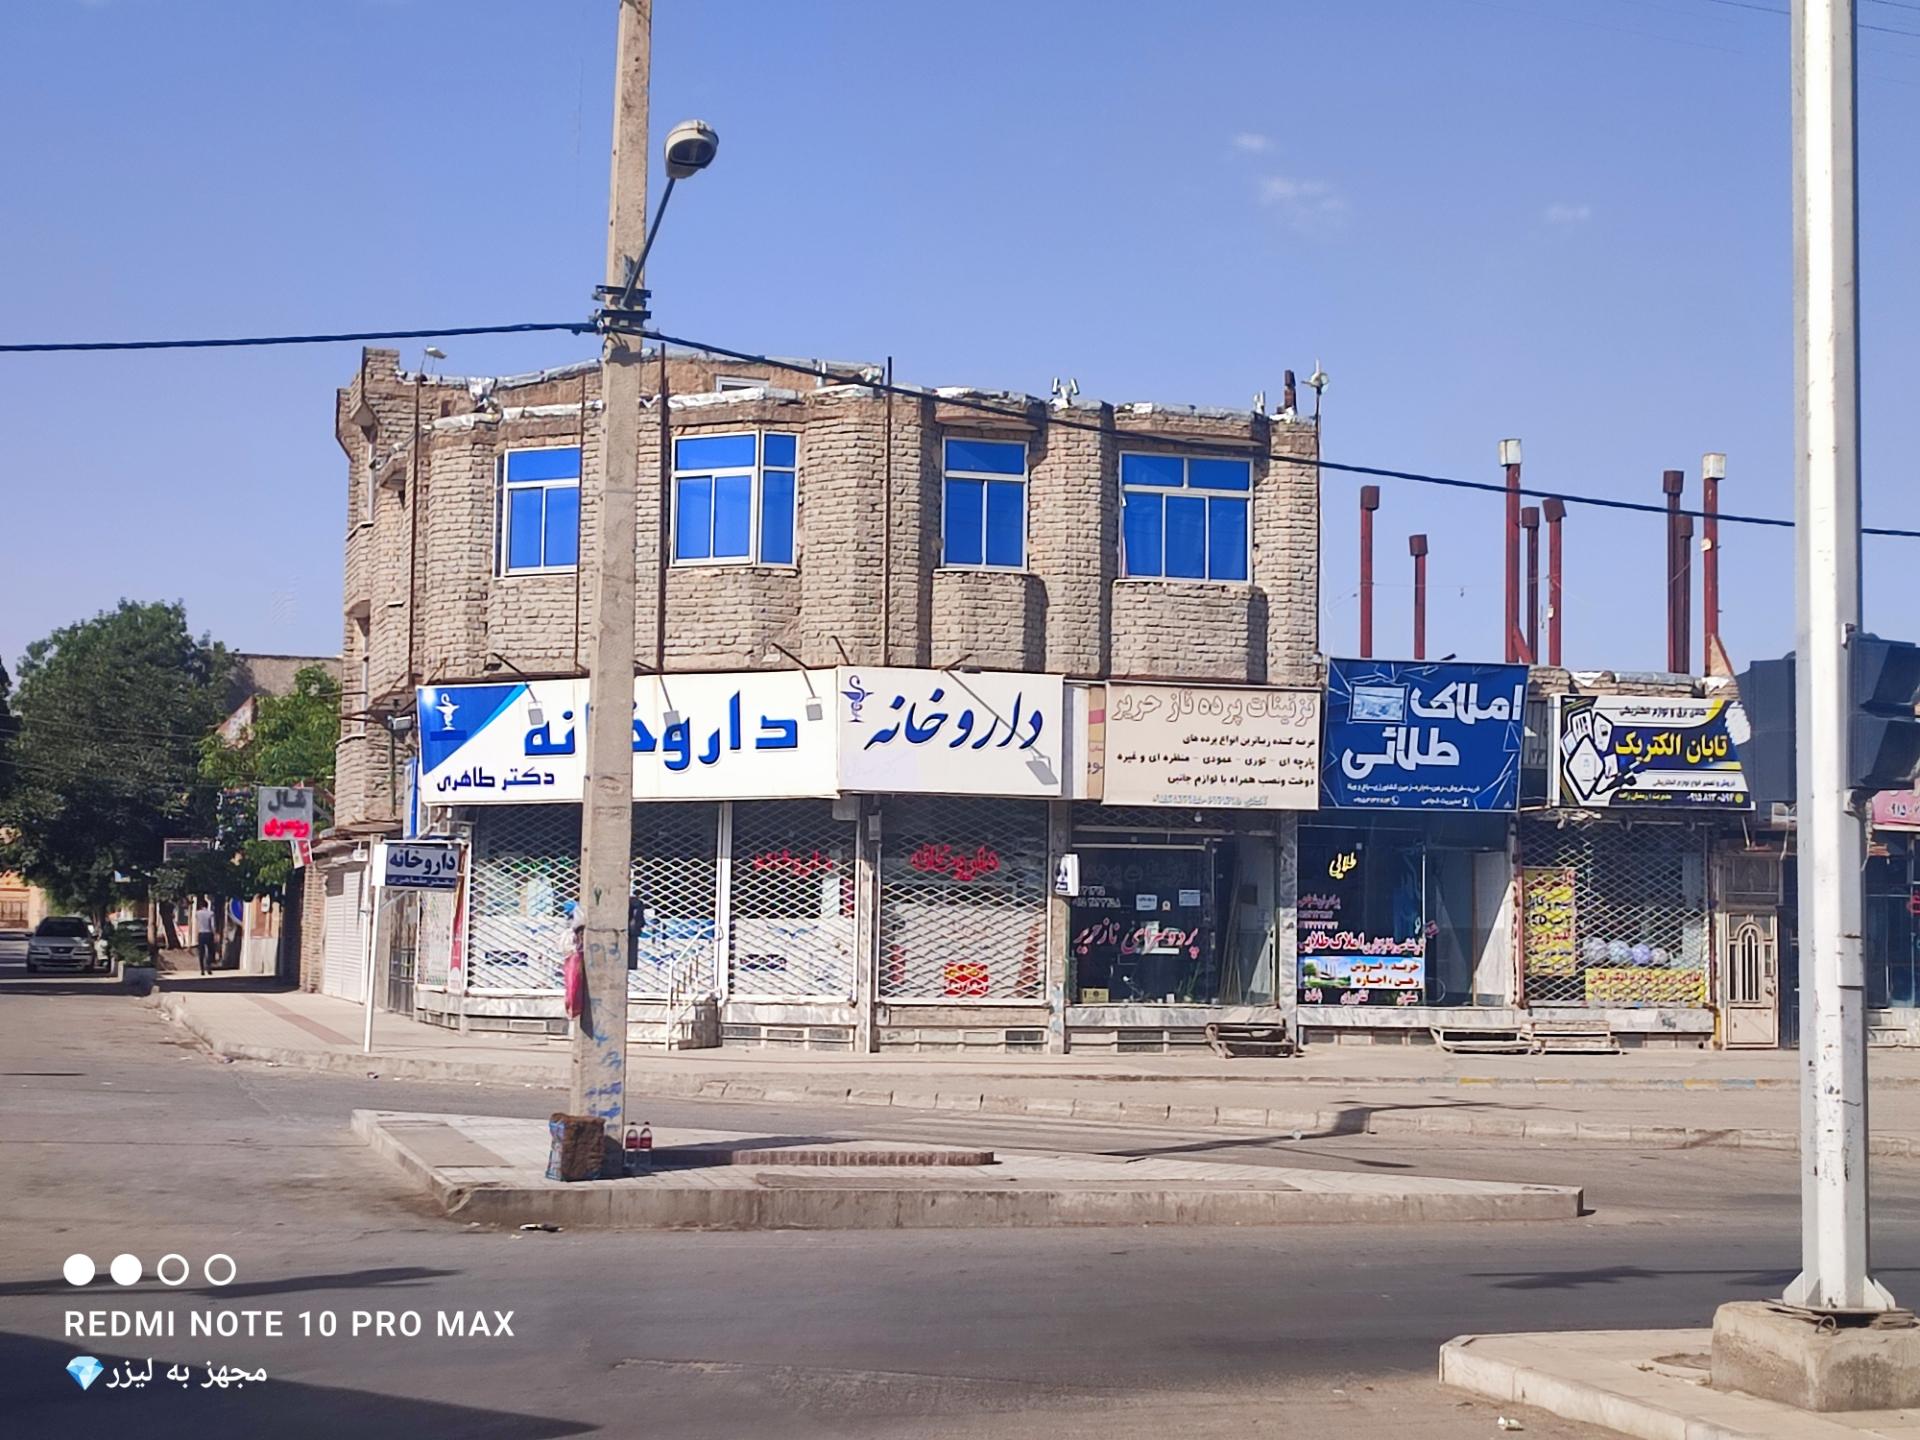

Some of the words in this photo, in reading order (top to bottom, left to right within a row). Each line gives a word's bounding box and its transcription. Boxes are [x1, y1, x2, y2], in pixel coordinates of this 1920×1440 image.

[1112, 693, 1163, 722] حریر
[1199, 695, 1243, 725] پرده
[1247, 691, 1315, 727] تزئینات
[1410, 682, 1523, 724] املاک
[864, 686, 1043, 750] داروخانه
[525, 689, 799, 771] داروخنه
[1219, 735, 1239, 746] انواع
[1117, 751, 1137, 761] غیره
[1342, 727, 1460, 779] طلائی
[1615, 731, 1681, 763] الکتریک
[1686, 734, 1728, 763] تابان
[1202, 757, 1232, 765] عمودی
[1244, 756, 1267, 766] توری
[1293, 758, 1315, 770] پارچه
[437, 767, 496, 792] طاهری
[501, 767, 555, 790] دکتر
[1167, 773, 1192, 785] جانبی
[1194, 774, 1218, 787] لوازم
[1220, 774, 1227, 784] با
[1230, 774, 1255, 785] همراه
[1287, 777, 1315, 787] دوخت
[267, 789, 307, 812] شال
[263, 817, 310, 838] روسری
[389, 849, 456, 875] داروخانه
[1097, 917, 1120, 945] ناز
[1332, 931, 1365, 950] املاک
[1351, 962, 1383, 974] فروش
[1390, 963, 1420, 974] خرید
[1356, 974, 1387, 986] اجاره
